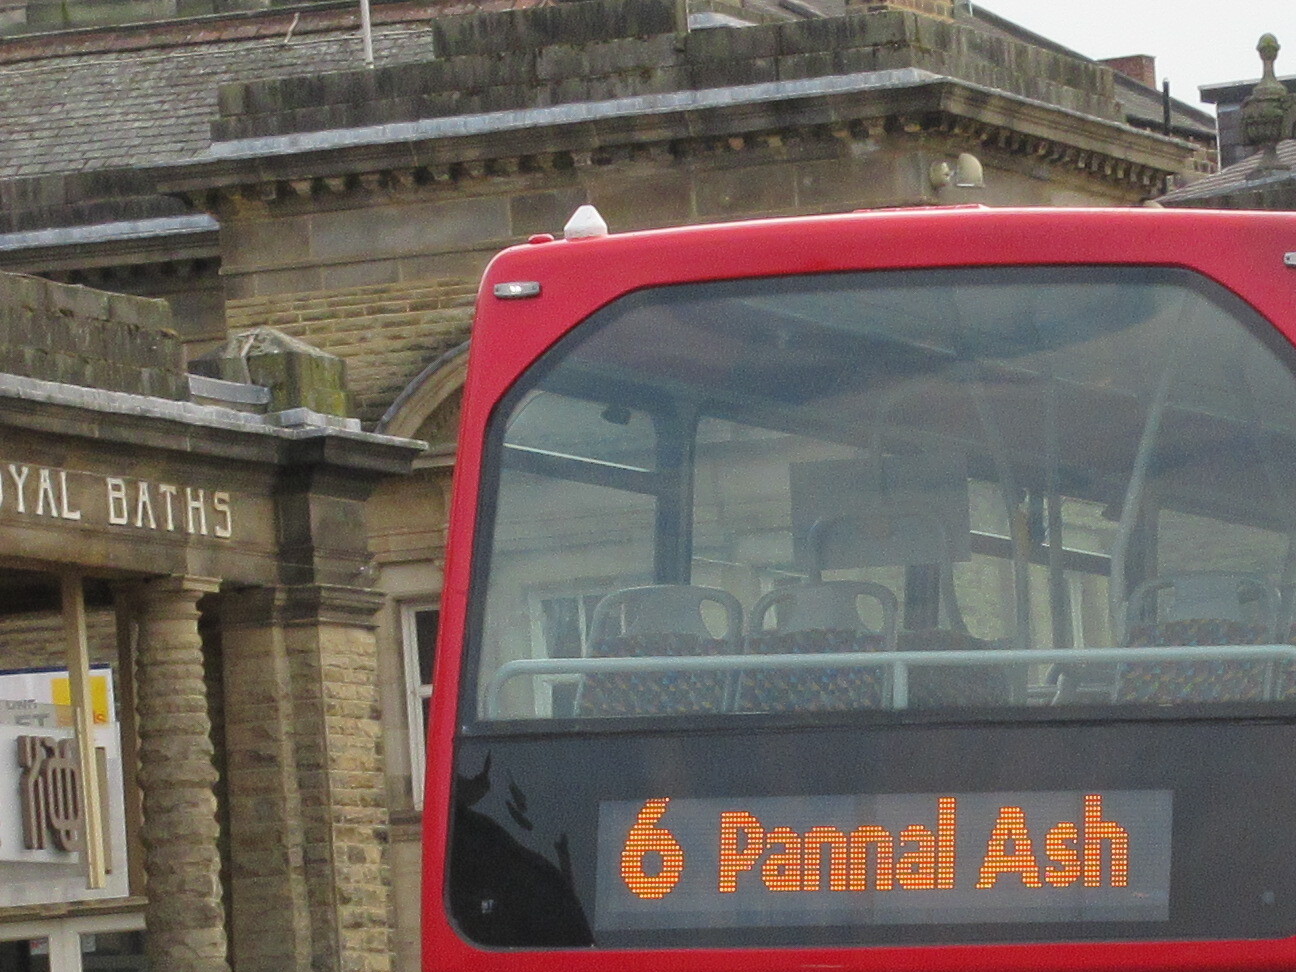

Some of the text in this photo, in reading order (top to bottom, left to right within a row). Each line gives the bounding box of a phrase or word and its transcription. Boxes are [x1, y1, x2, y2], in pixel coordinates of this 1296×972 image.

[0, 463, 232, 538] YAL BATHS
[619, 794, 1130, 900] 6 Pannal Ash
